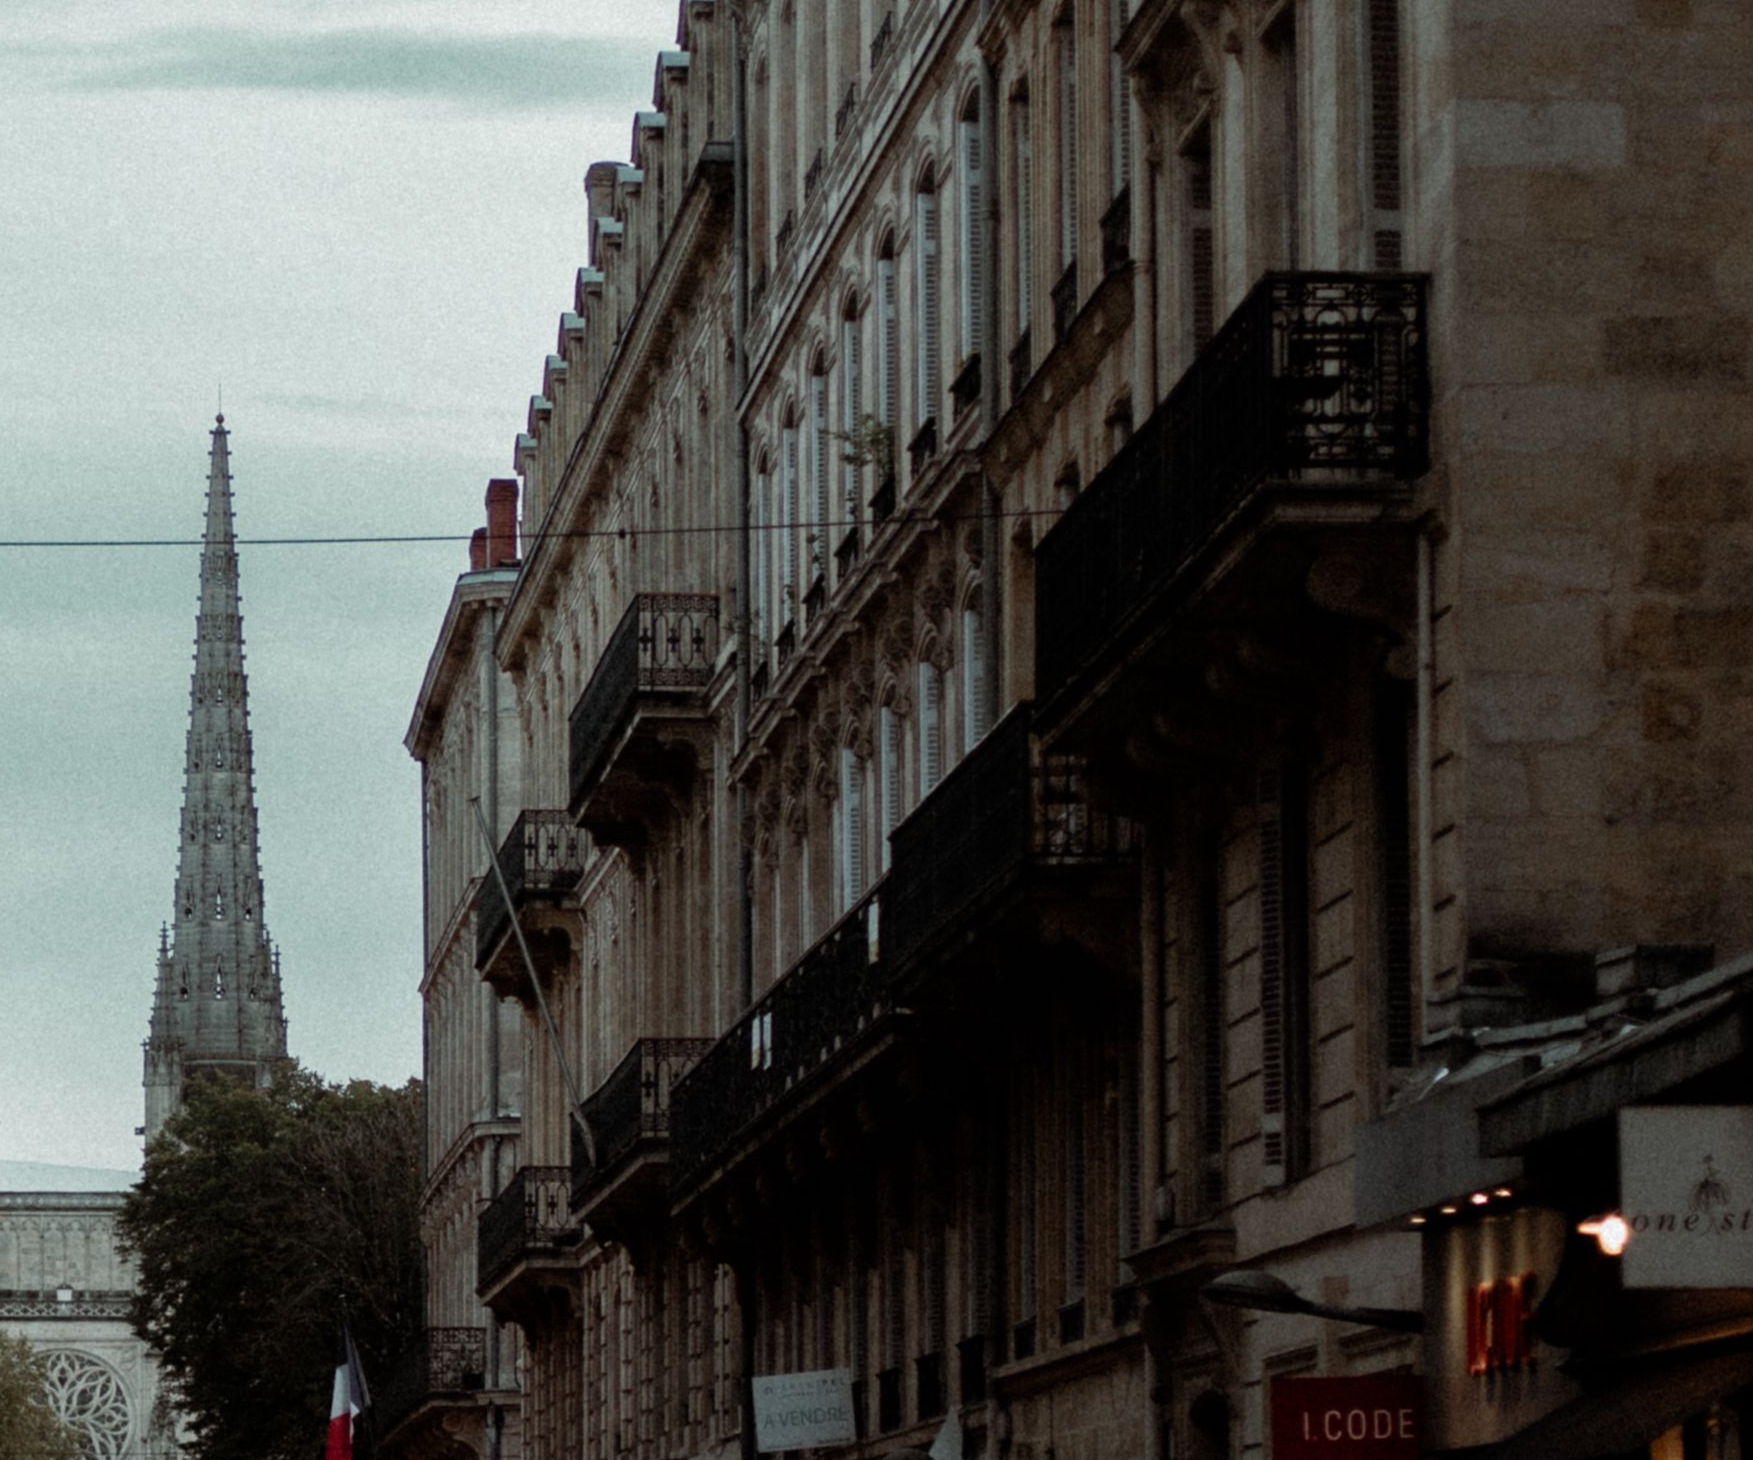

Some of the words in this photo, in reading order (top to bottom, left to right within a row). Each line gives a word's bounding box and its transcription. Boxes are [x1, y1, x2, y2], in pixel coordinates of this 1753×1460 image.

[1631, 1213, 1700, 1232] one
[778, 1406, 850, 1427] VENDRE
[1302, 1407, 1416, 1442] I.CODE
